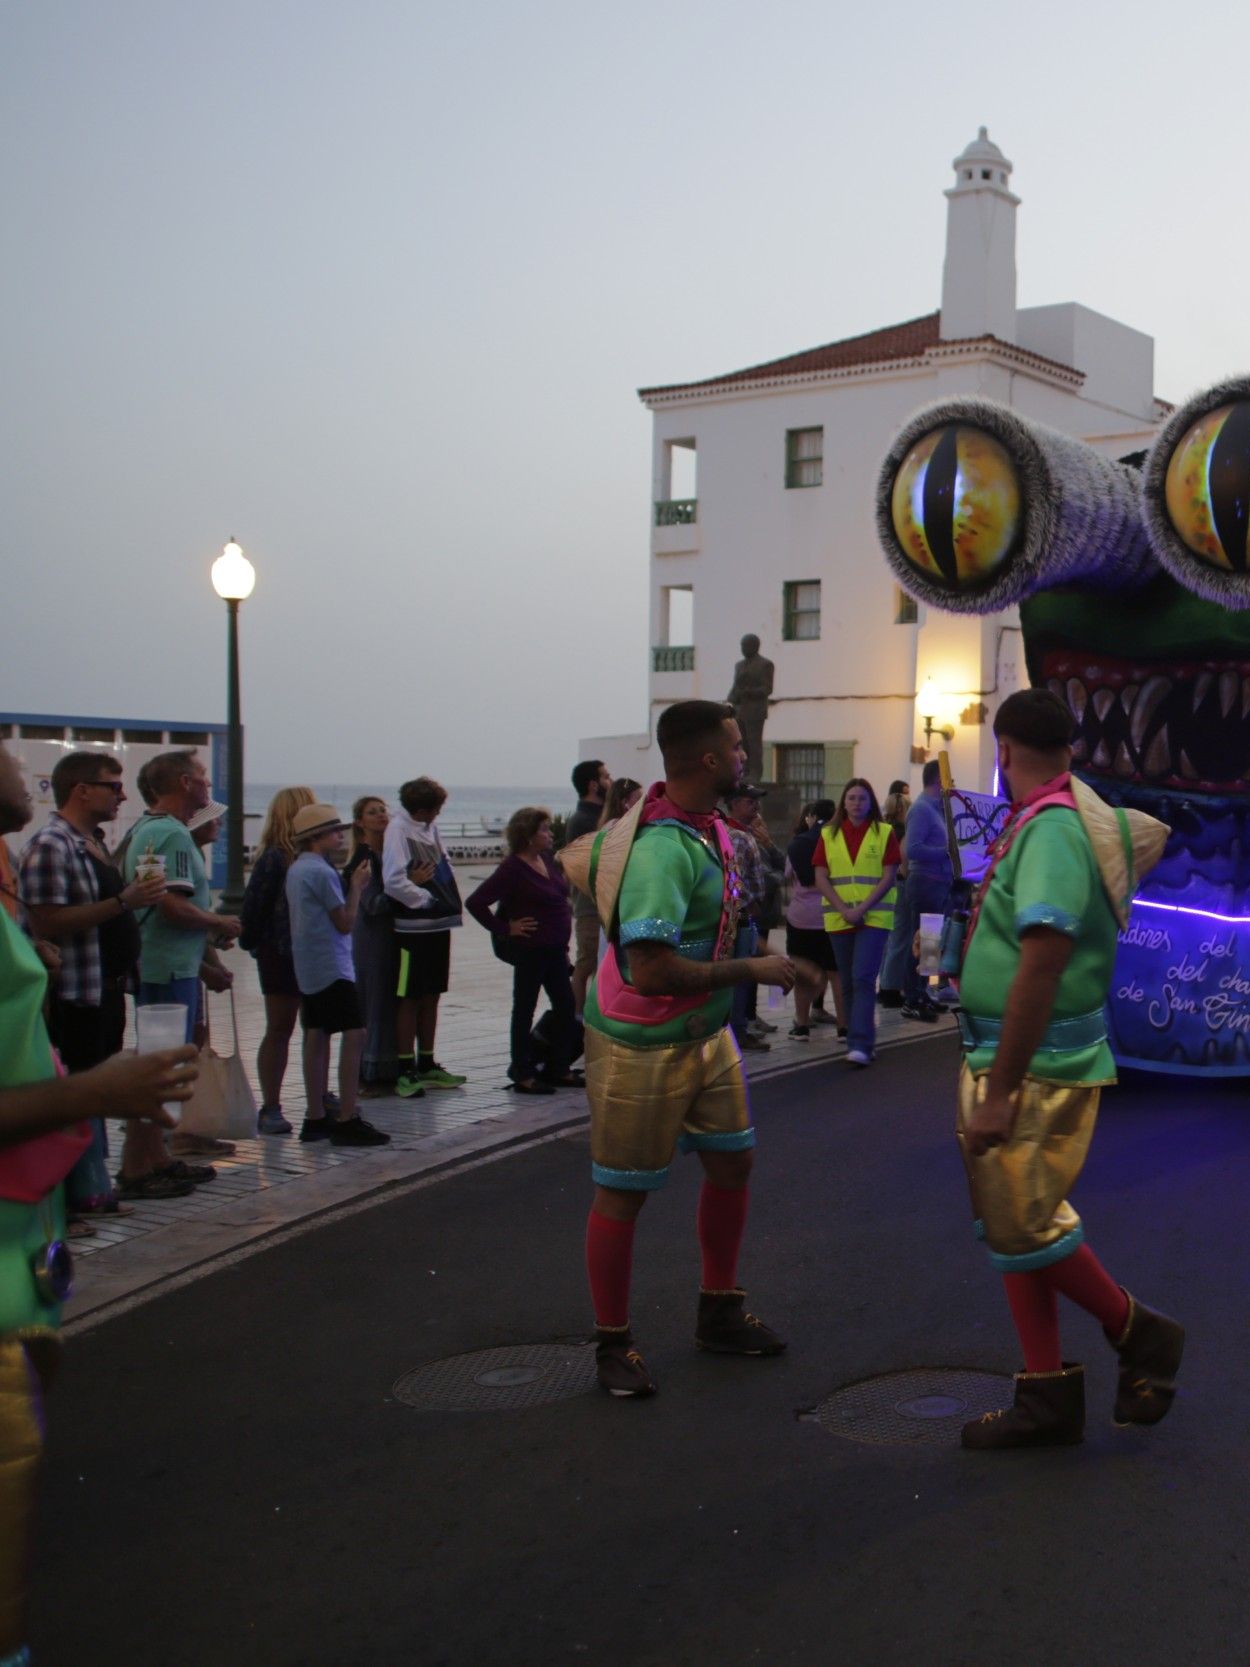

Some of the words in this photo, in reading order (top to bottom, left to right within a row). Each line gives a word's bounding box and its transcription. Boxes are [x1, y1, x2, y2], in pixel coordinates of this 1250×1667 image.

[1199, 929, 1235, 957] del
[1166, 953, 1210, 983] del
[1116, 980, 1145, 1002] de
[1148, 983, 1198, 1028] San
